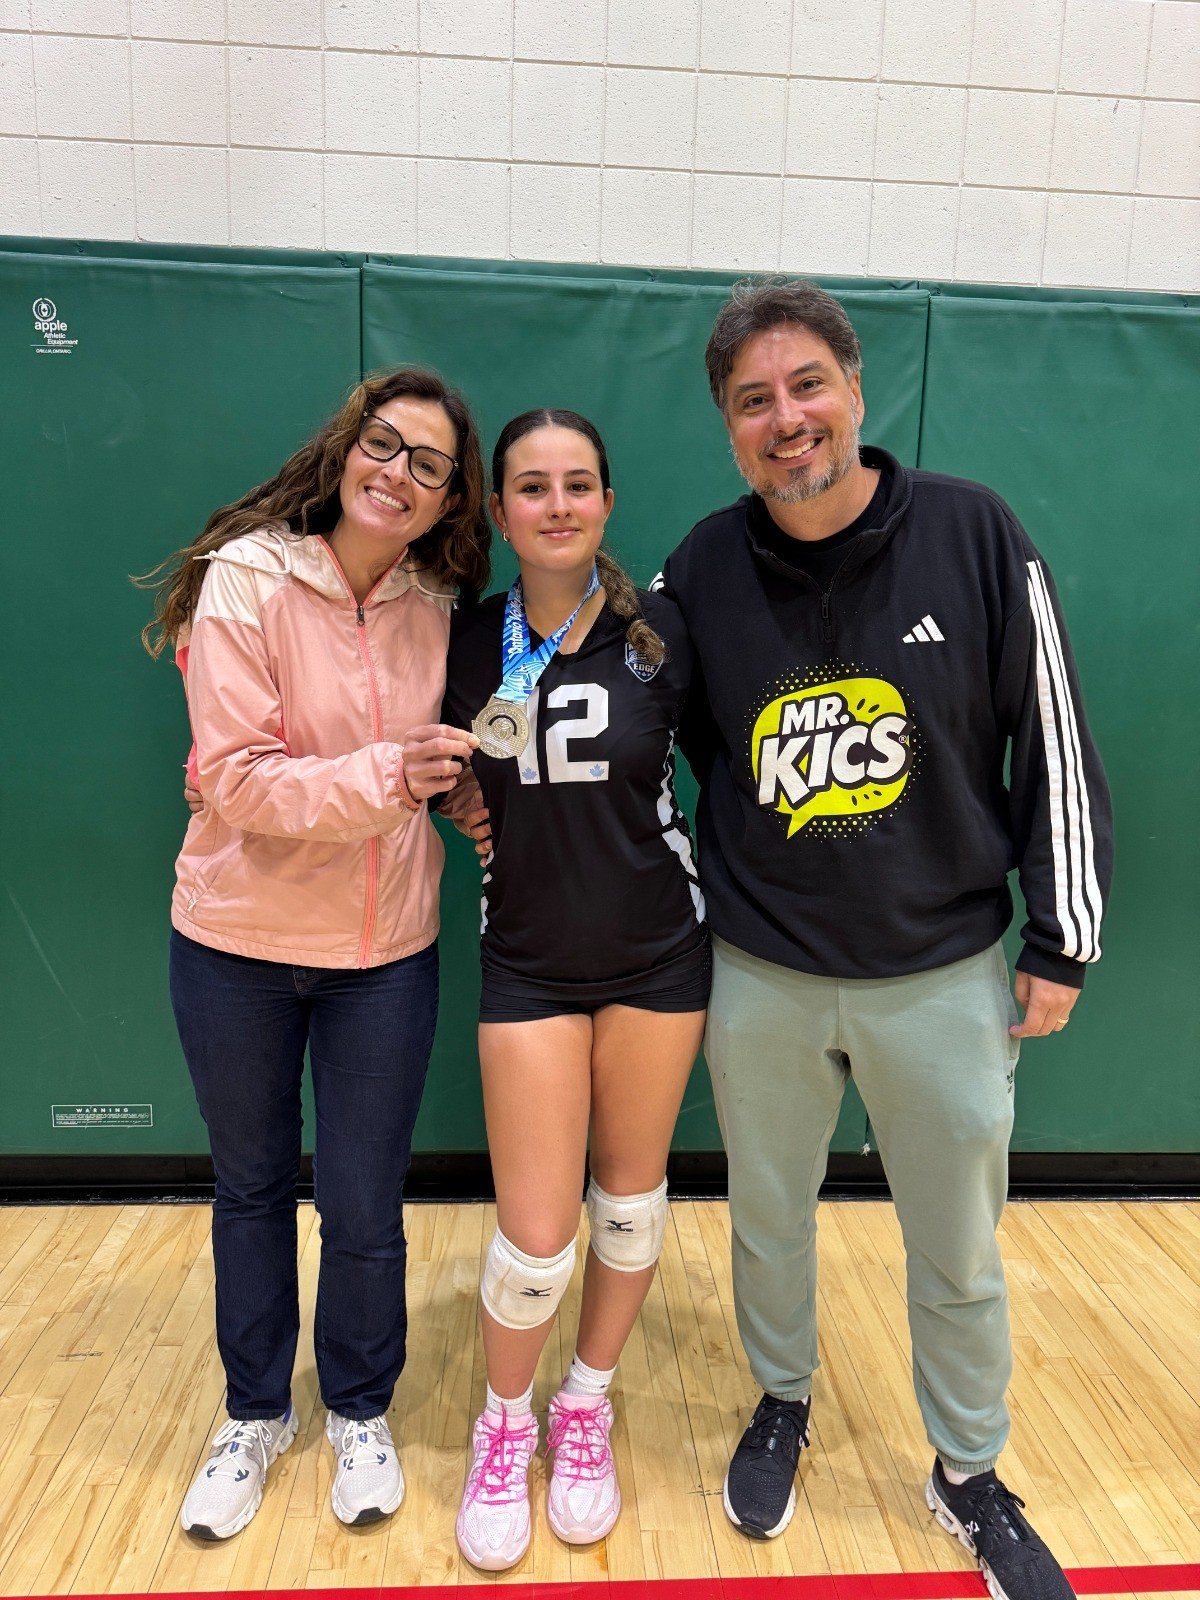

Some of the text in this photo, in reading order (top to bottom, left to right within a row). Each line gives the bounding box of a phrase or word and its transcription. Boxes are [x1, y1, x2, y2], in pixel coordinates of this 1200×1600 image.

[34, 320, 68, 333] apple
[508, 621, 524, 656] Ontario
[633, 663, 656, 674] EDGE
[516, 683, 610, 785] 12
[781, 695, 850, 736] MR.
[758, 716, 908, 805] KICS
